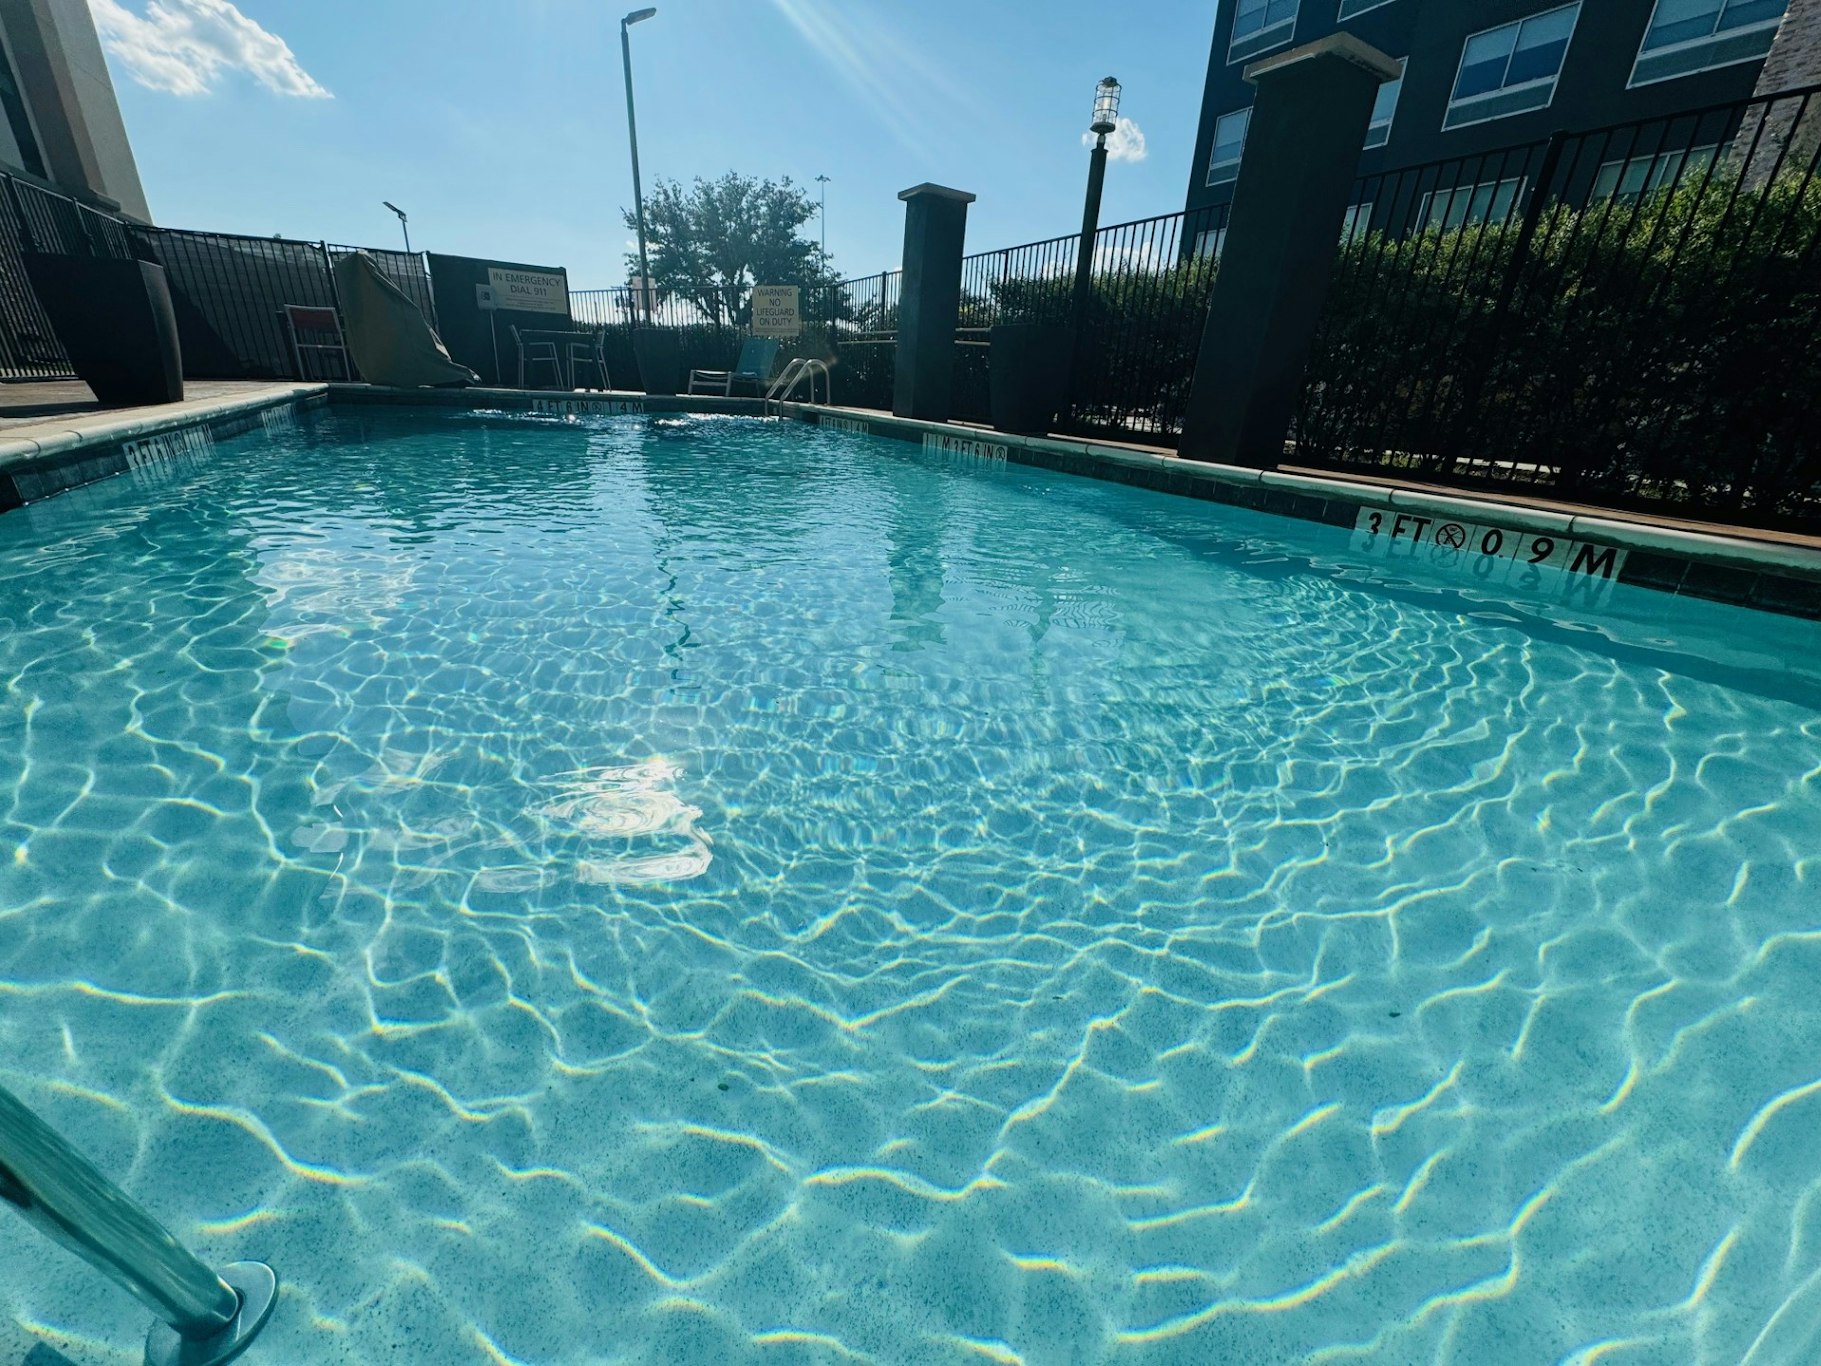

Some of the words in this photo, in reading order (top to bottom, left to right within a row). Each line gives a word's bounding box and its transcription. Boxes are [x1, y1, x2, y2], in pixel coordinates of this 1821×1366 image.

[492, 271, 503, 281] IN
[505, 273, 561, 287] EMERGENCY
[510, 284, 532, 295] DIAL
[533, 287, 547, 297] 911
[757, 288, 793, 297] WARNING
[769, 298, 781, 307] NO
[756, 307, 795, 316] LIFEGUARD
[759, 317, 770, 326] ON
[771, 317, 792, 326] DUTY
[1368, 511, 1382, 535] 3
[1392, 515, 1432, 543] FT
[1569, 543, 1618, 579] M
